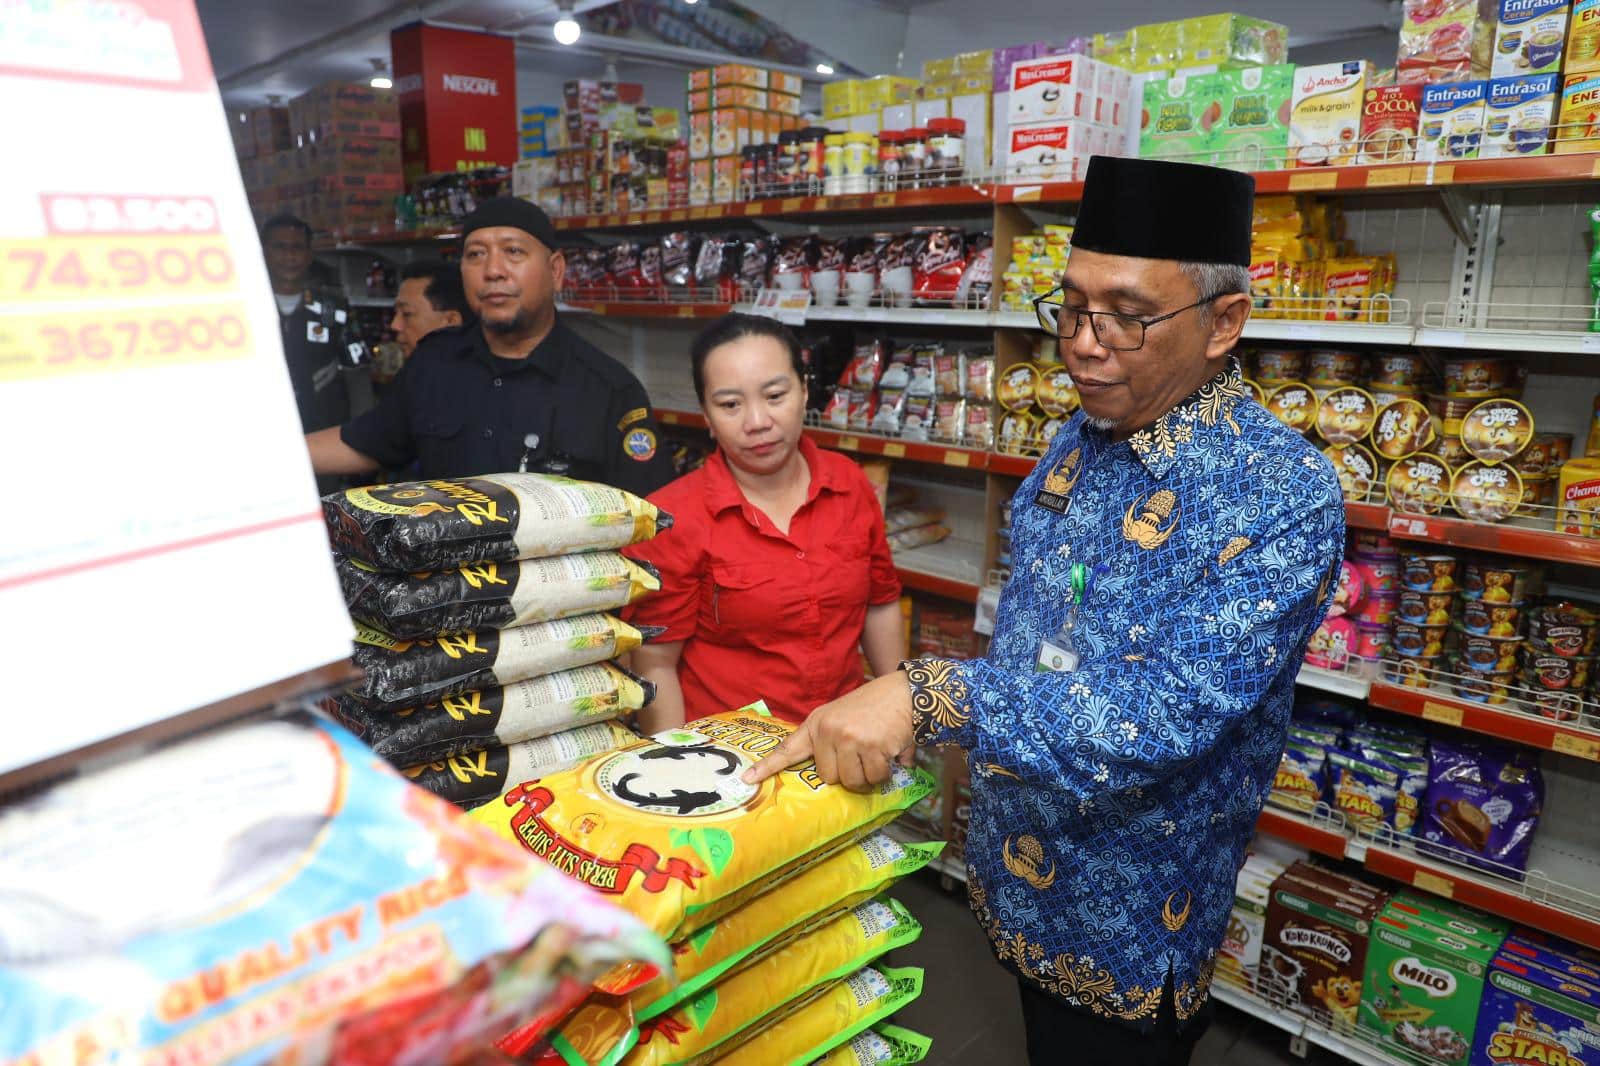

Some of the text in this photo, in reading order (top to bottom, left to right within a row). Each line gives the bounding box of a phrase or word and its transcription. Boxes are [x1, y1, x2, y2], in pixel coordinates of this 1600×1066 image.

[1426, 85, 1482, 101] Entrasol
[1492, 78, 1551, 96] Entrasol
[1365, 99, 1416, 116] COCOA
[7, 247, 236, 292] 74.900
[40, 314, 247, 365] 367.900
[518, 815, 554, 858] SUPER
[546, 843, 580, 876] SLYP
[575, 859, 619, 890] BERAS
[158, 904, 365, 1022] QUALITY
[376, 865, 471, 928] RICE
[1398, 963, 1449, 992] MILO
